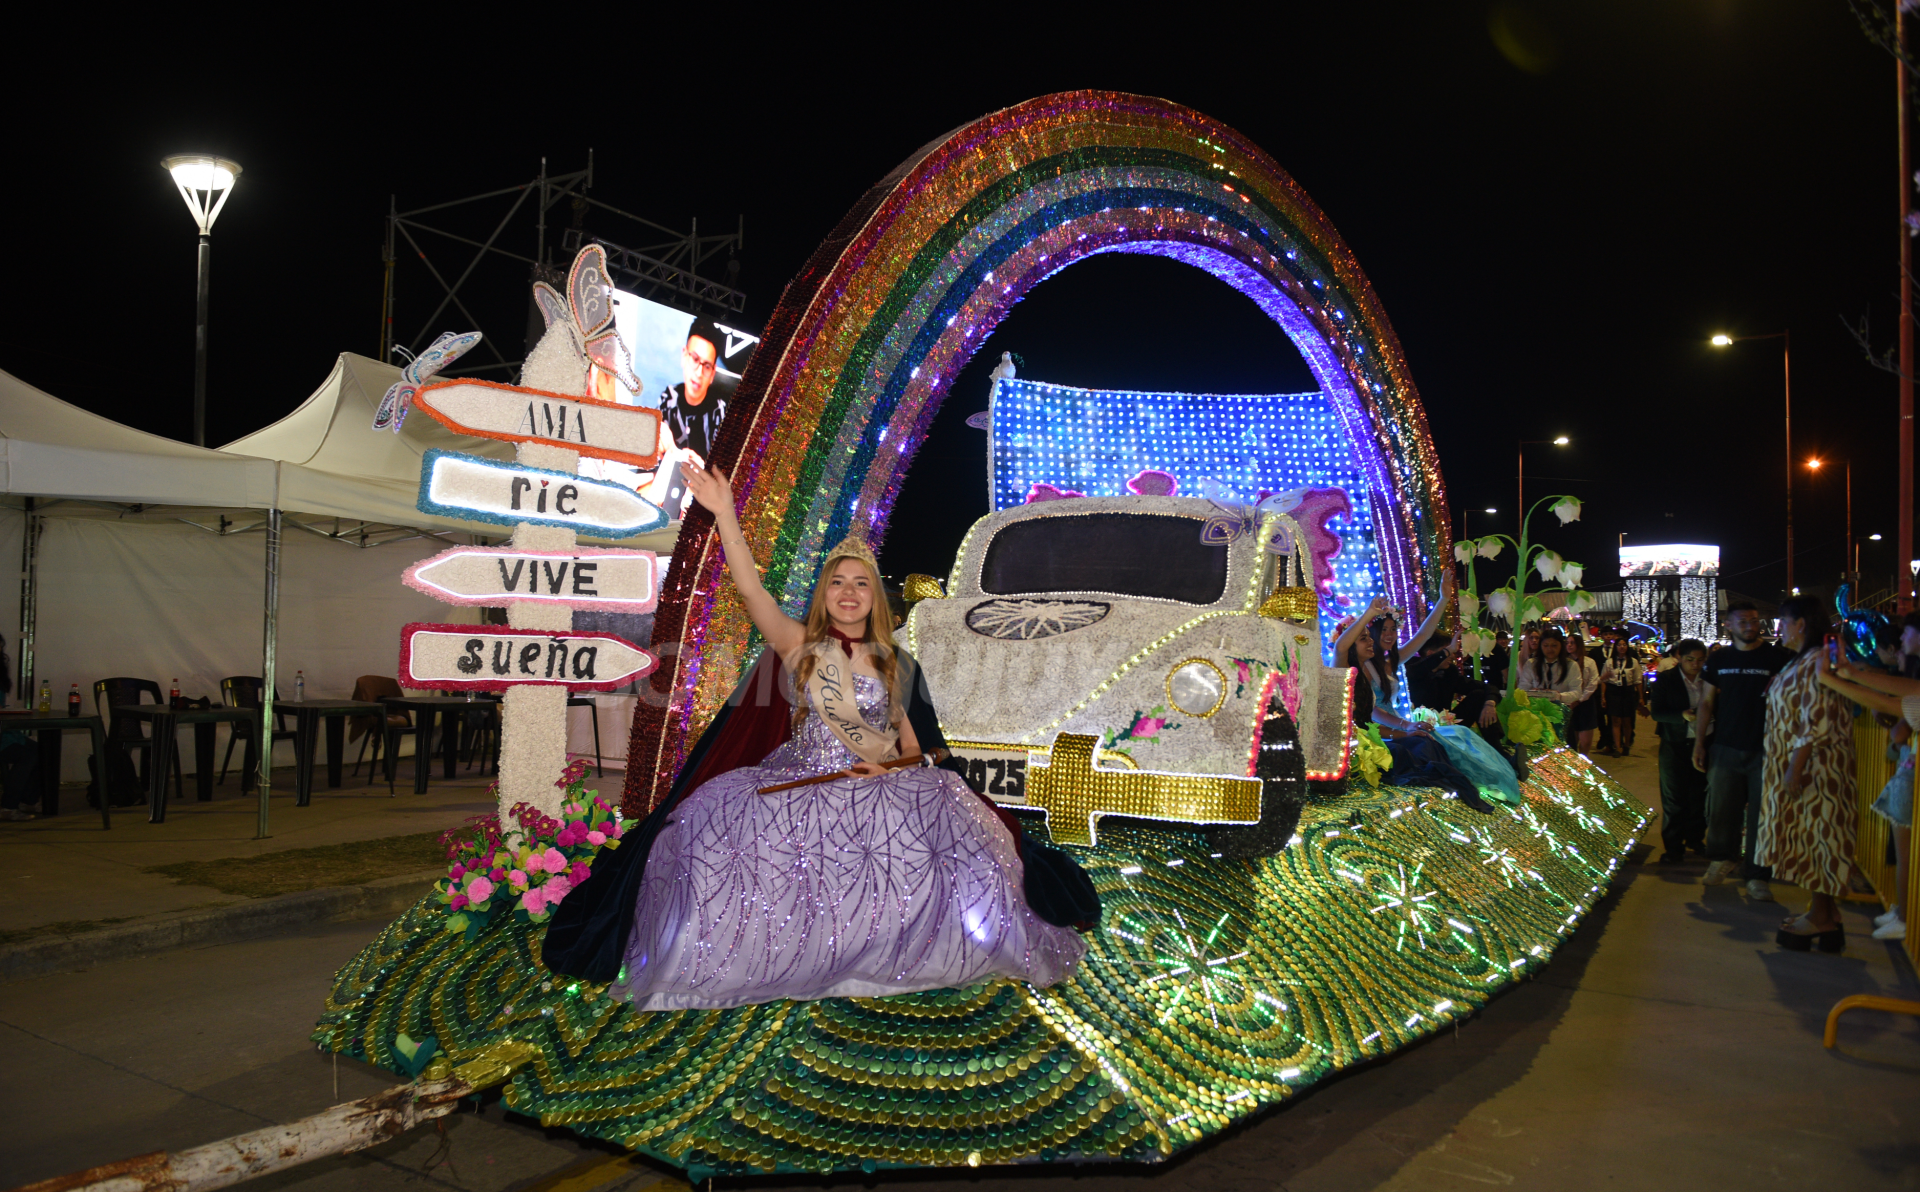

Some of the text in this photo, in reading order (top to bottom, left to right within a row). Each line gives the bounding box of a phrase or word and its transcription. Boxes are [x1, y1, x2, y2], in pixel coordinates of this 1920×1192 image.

[518, 400, 588, 444] AMA
[510, 476, 579, 516] rie
[498, 558, 598, 597] VIVE
